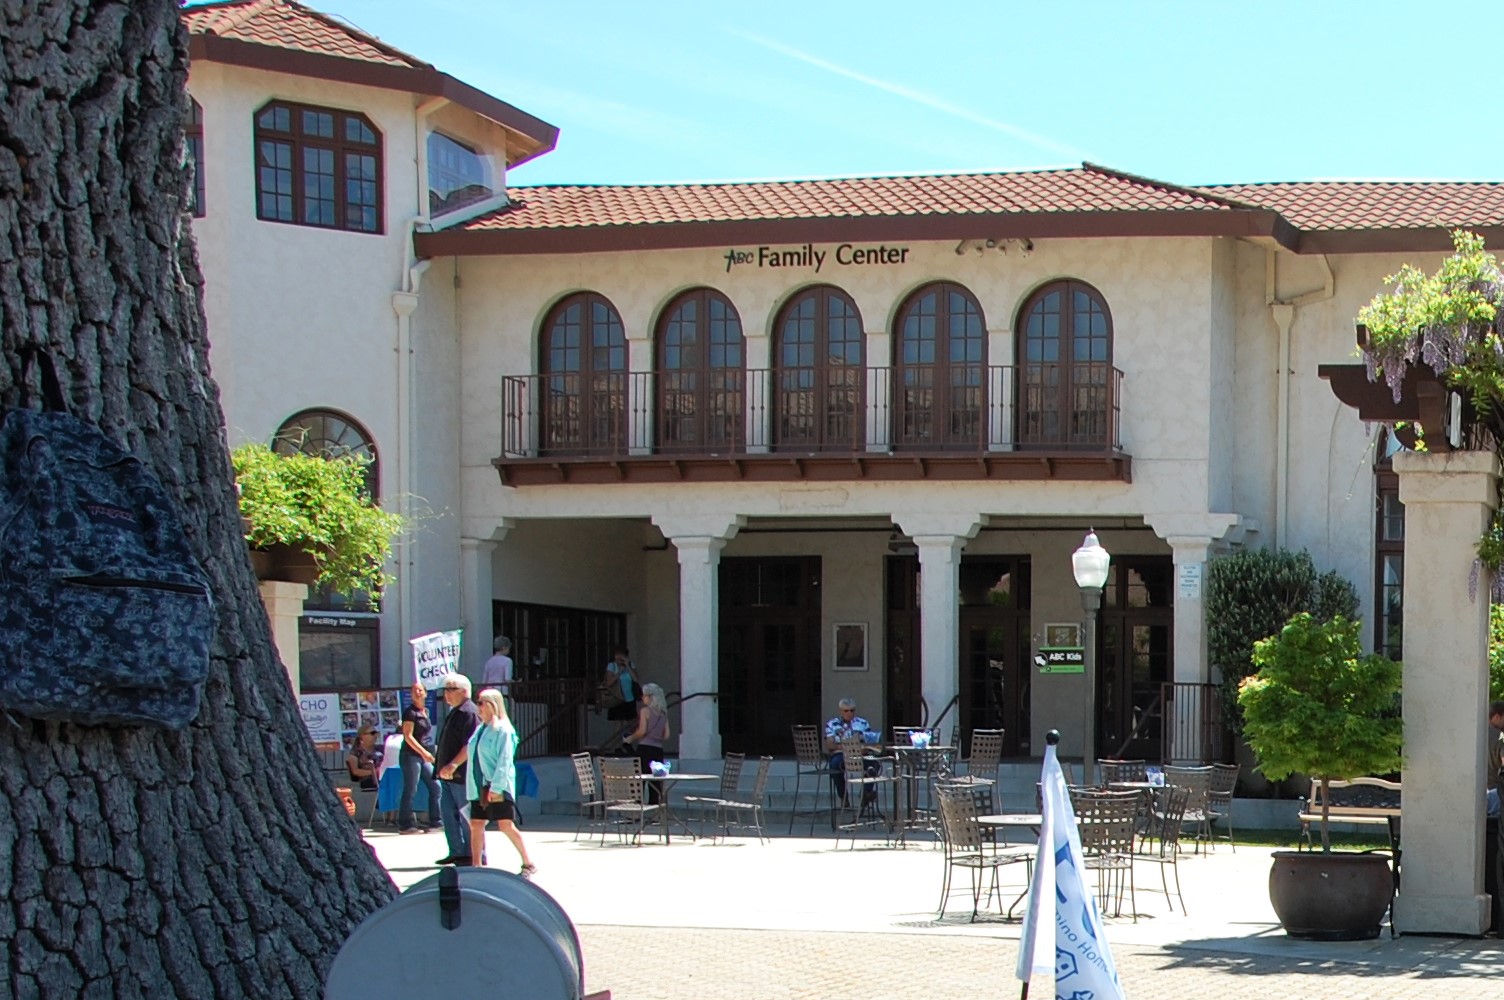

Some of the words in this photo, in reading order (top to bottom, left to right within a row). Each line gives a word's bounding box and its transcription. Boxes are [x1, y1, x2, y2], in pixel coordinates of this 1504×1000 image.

[724, 249, 754, 273] ABC
[758, 243, 826, 273] Family
[836, 244, 910, 265] Center
[1049, 652, 1065, 661] ABC
[1066, 652, 1082, 661] Kids
[300, 699, 328, 711] CHO
